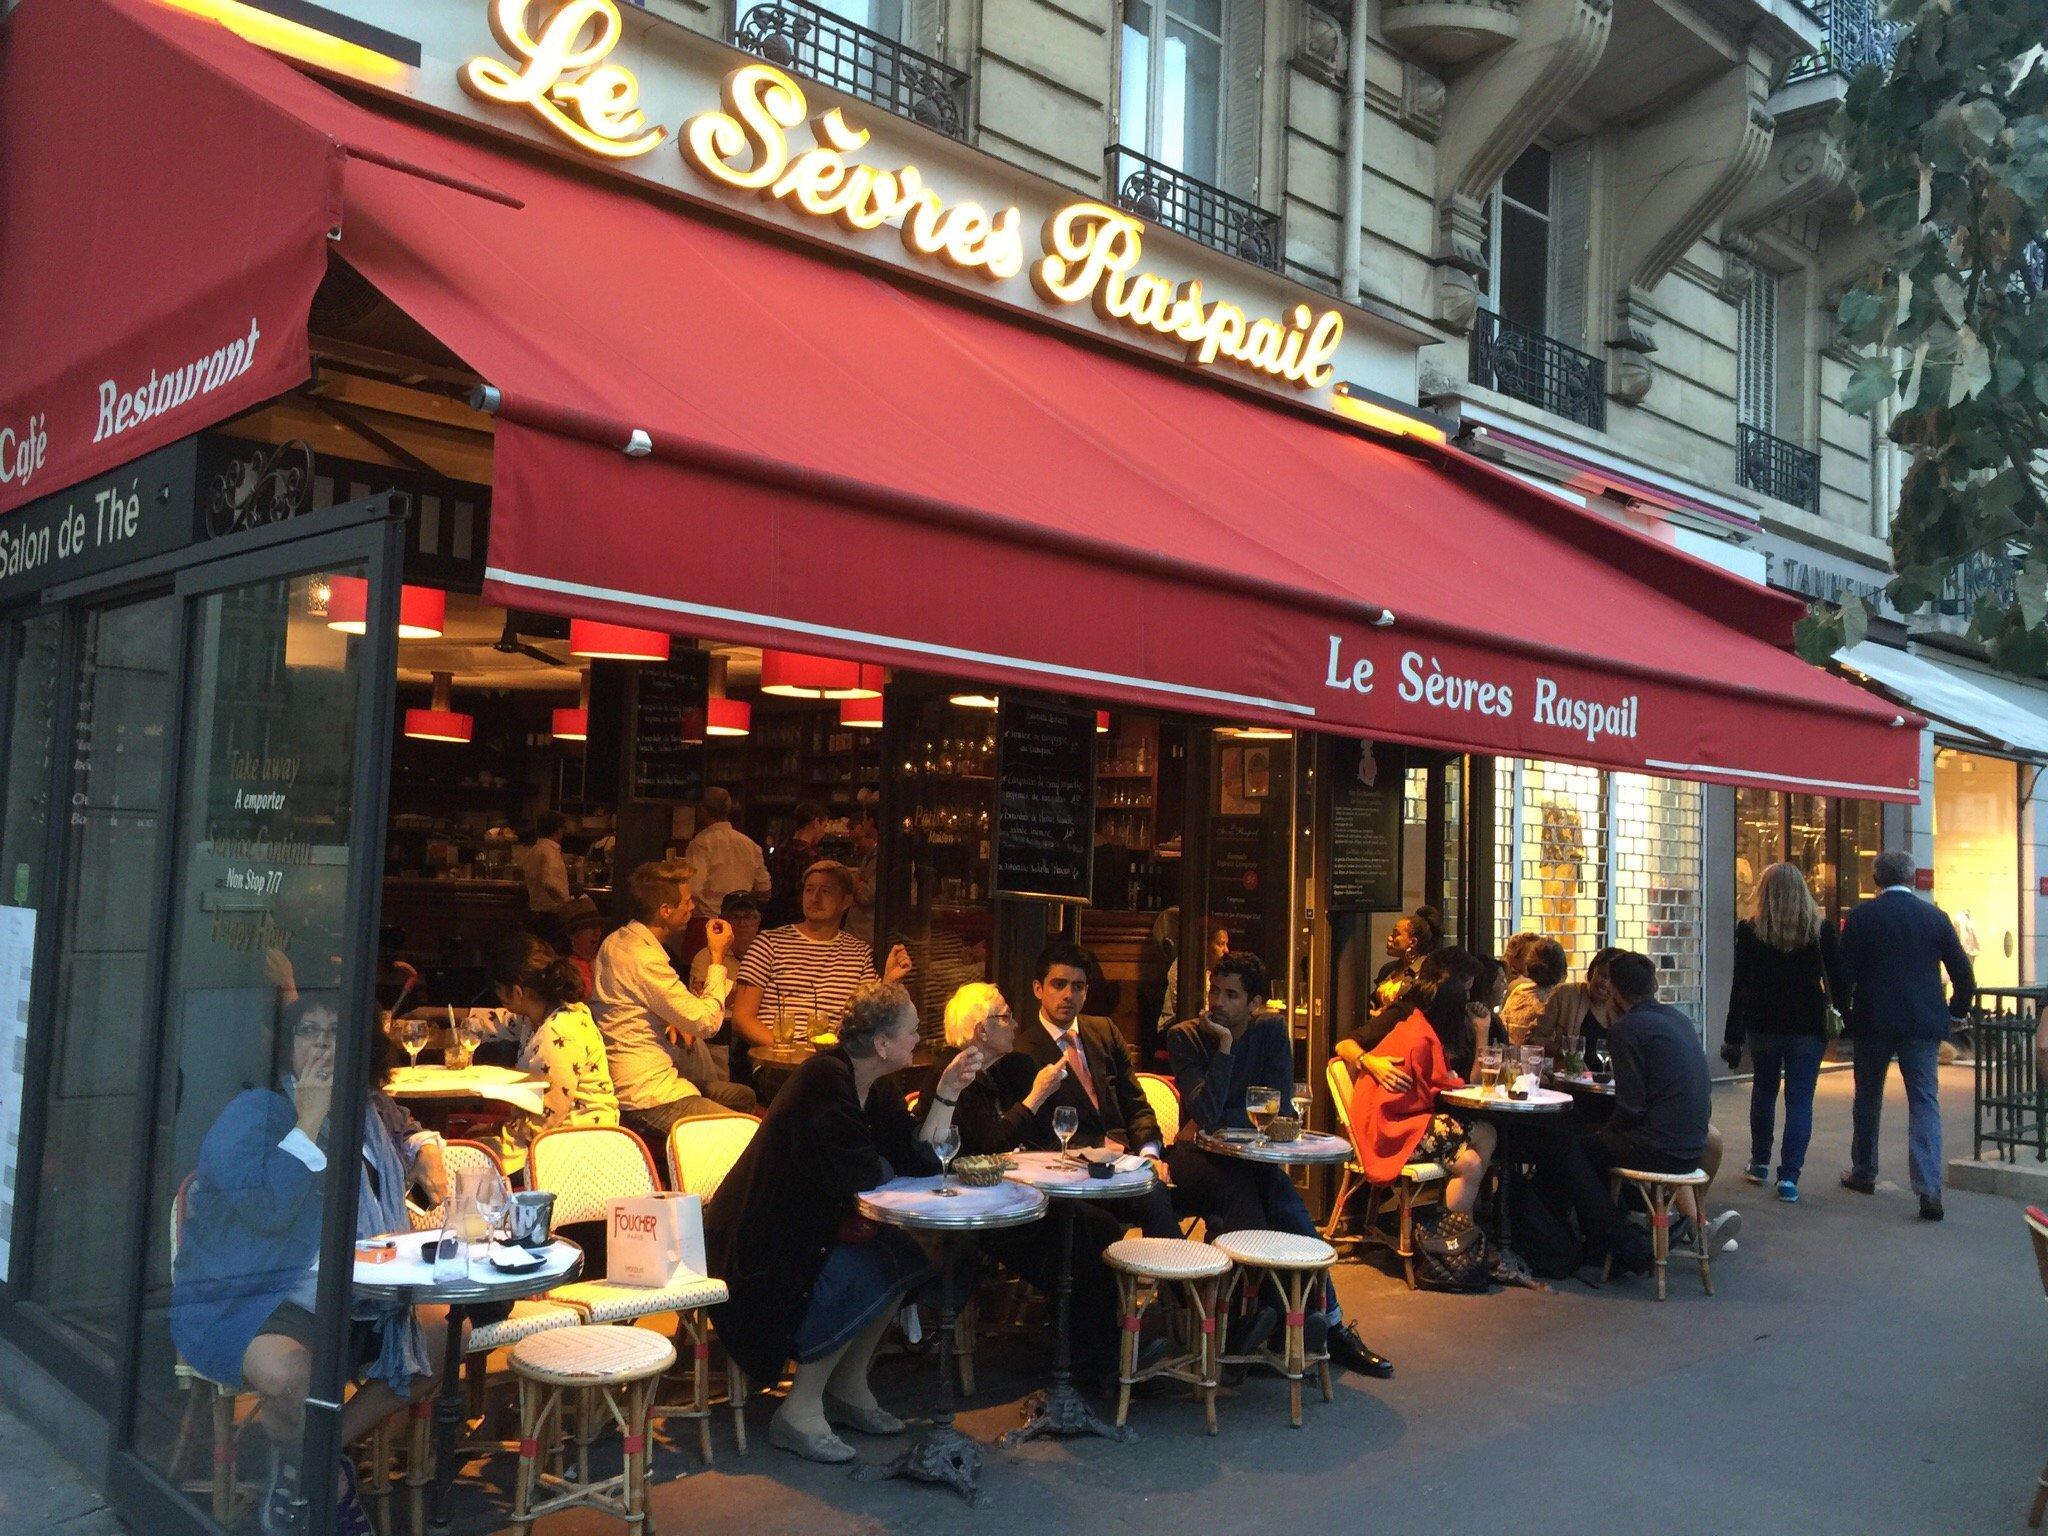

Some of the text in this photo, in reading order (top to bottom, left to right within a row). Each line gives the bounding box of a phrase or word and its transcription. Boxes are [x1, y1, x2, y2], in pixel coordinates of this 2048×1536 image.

[457, 0, 1345, 391] Le Sèvres Raspail
[0, 316, 260, 487] Café Restaurant
[0, 477, 140, 580] Salon de Thé
[1325, 635, 1640, 743] Le Sèvres Raspail
[234, 788, 286, 815] A emporter
[226, 867, 283, 896] Non Stop 7/7
[614, 1206, 657, 1241] FOUCHER
